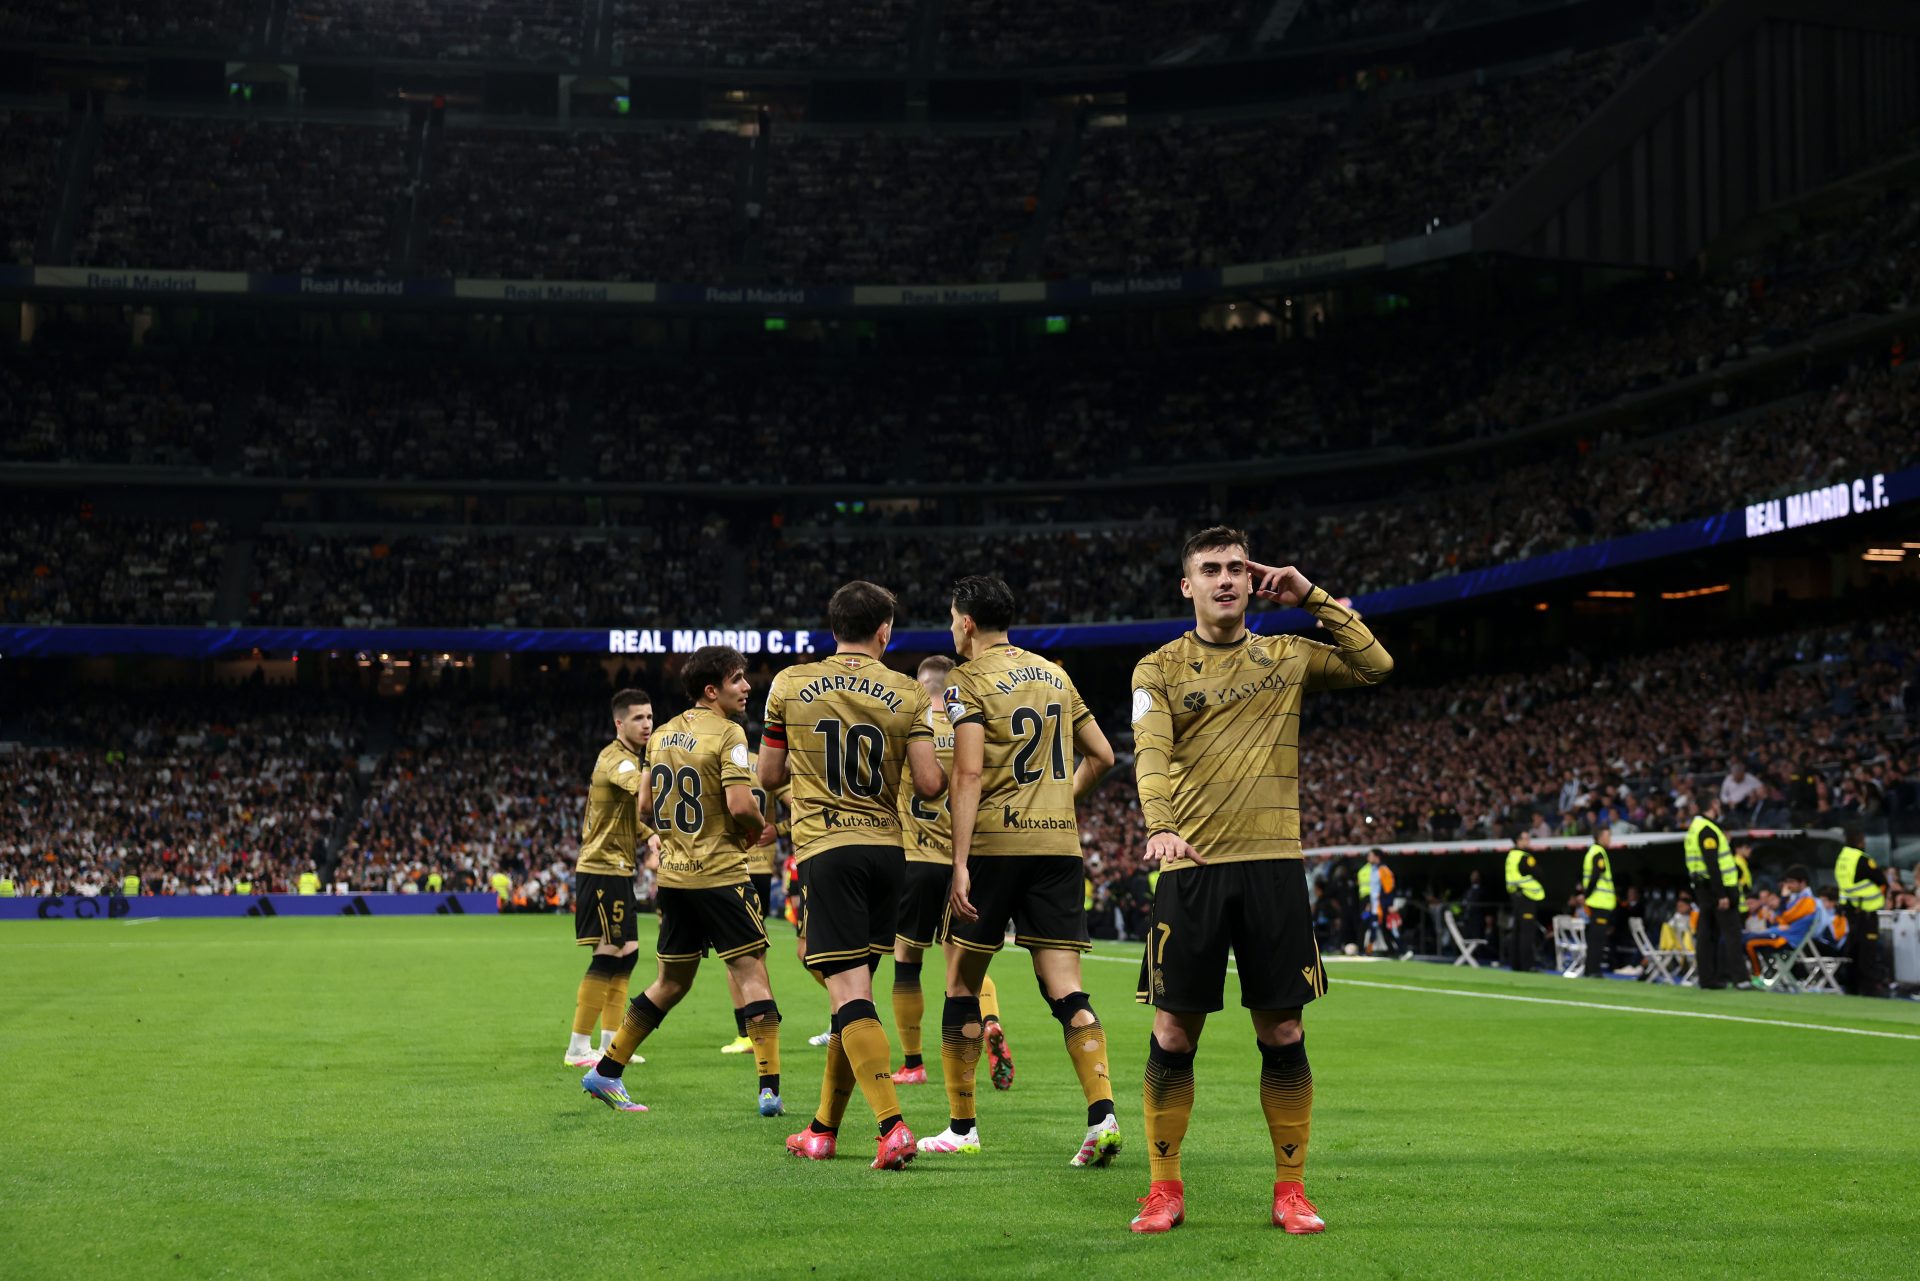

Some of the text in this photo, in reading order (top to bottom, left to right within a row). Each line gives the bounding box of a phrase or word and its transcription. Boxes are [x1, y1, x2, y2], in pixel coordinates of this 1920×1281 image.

[88, 273, 196, 290] Real Madrid
[301, 277, 402, 295] Real Madrid
[504, 285, 607, 301] Real Madrid
[1091, 275, 1182, 296] Real Madrid
[706, 287, 804, 303] Real Madrid
[903, 288, 999, 304] Real Madrid
[1745, 500, 1785, 538] REAL
[1786, 483, 1849, 528] MADRID
[609, 630, 666, 653] REAL
[672, 630, 761, 653] MADRID
[996, 666, 1064, 695] N.AGUERD
[799, 675, 903, 714] OYARZABAL
[661, 732, 697, 753] MARÍN
[1011, 703, 1067, 786] 21
[813, 719, 885, 798] 10
[651, 763, 704, 834] 28
[612, 899, 625, 923] 5
[1157, 921, 1171, 964] 7
